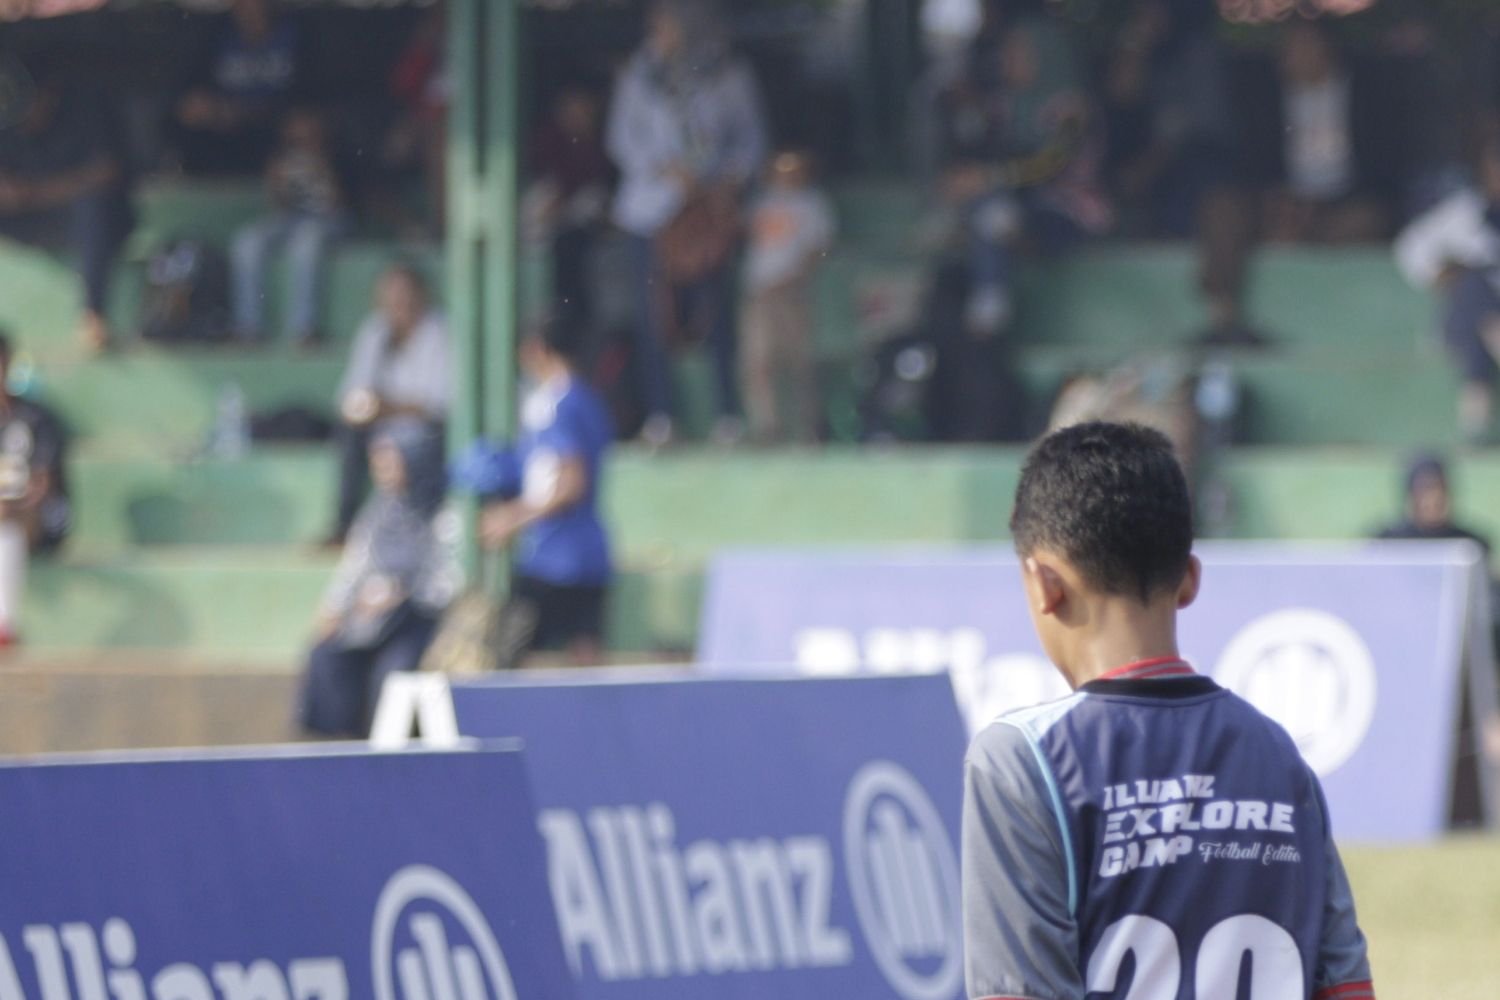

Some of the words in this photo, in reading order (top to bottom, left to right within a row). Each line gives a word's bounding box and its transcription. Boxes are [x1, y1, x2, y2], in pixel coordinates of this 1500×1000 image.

[1103, 800, 1296, 845] EXPLORE
[1098, 835, 1194, 878] CAMP
[1198, 841, 1261, 864] Football
[538, 801, 854, 981] Allianz
